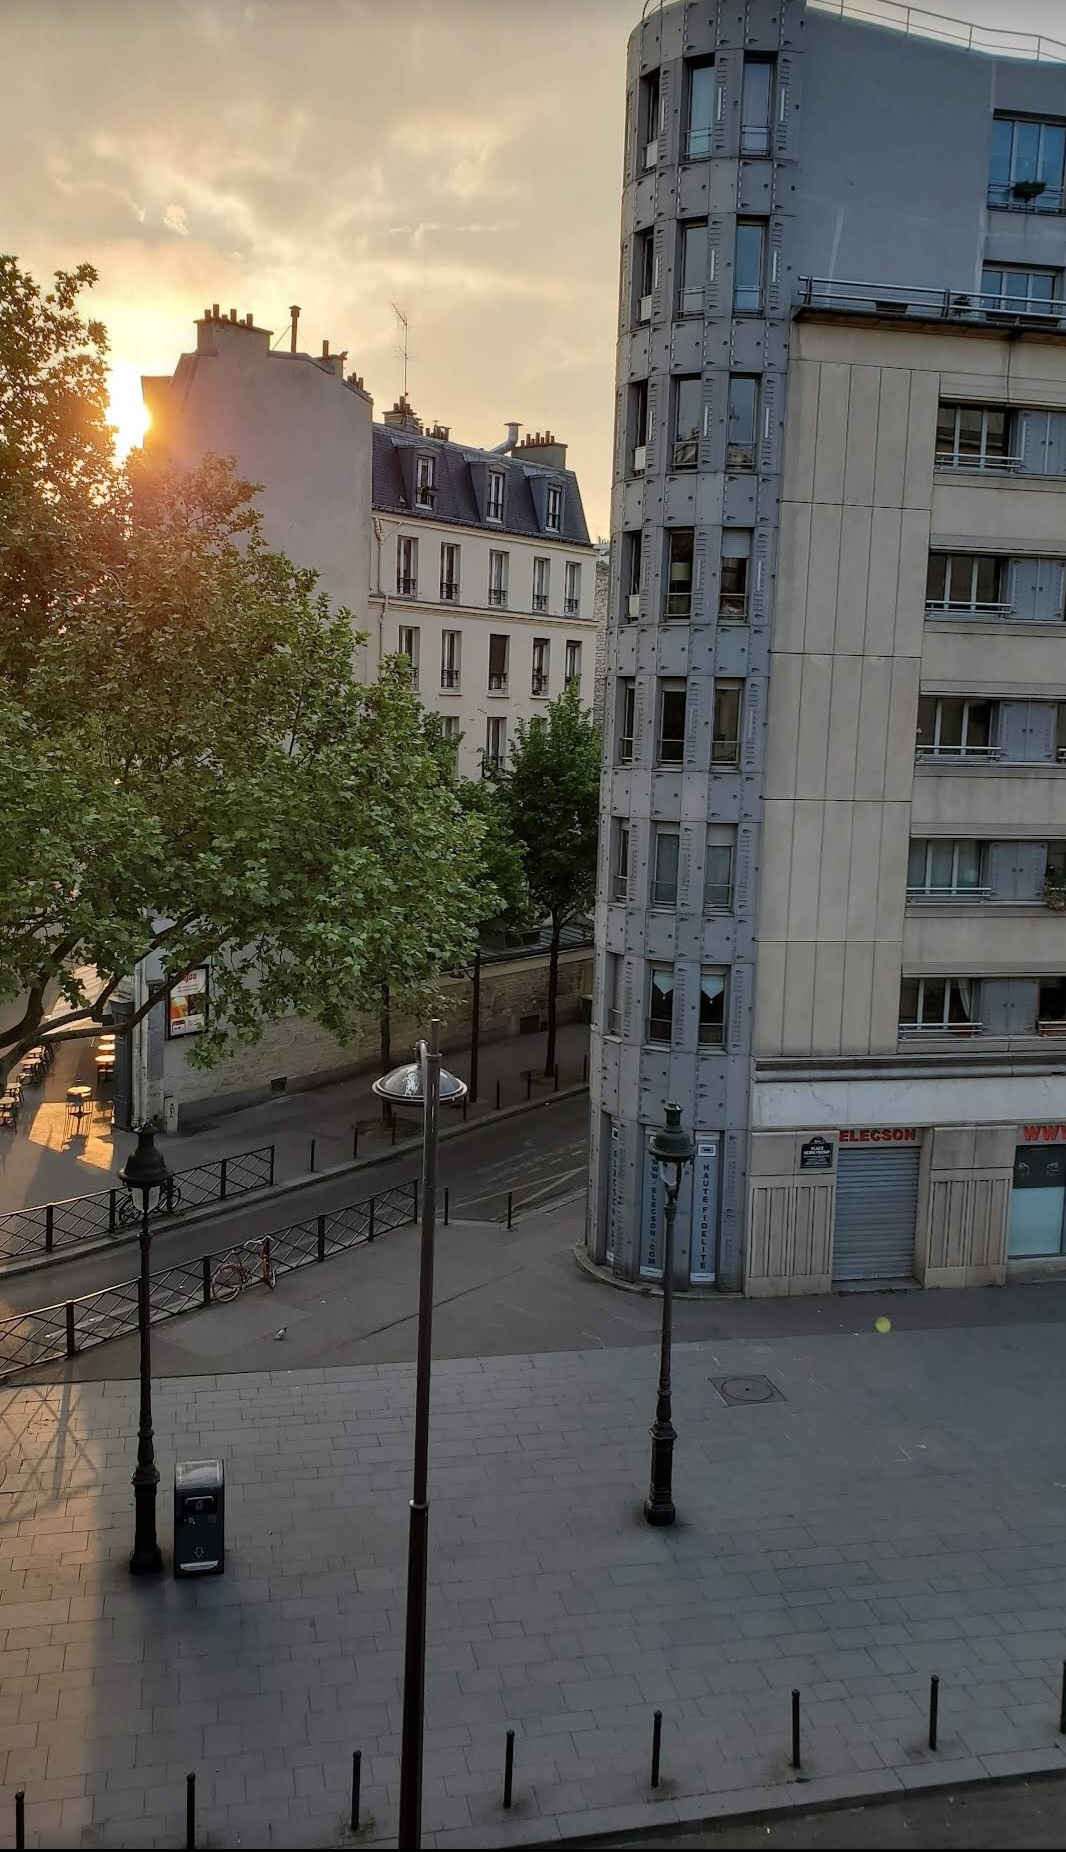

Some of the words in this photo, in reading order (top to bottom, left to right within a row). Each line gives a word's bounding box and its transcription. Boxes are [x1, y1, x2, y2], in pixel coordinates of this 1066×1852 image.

[838, 1128, 916, 1142] ELECSON
[1023, 1125, 1066, 1141] WW
[701, 1164, 710, 1203] HAUTE
[700, 1207, 709, 1269] FIDELITE
